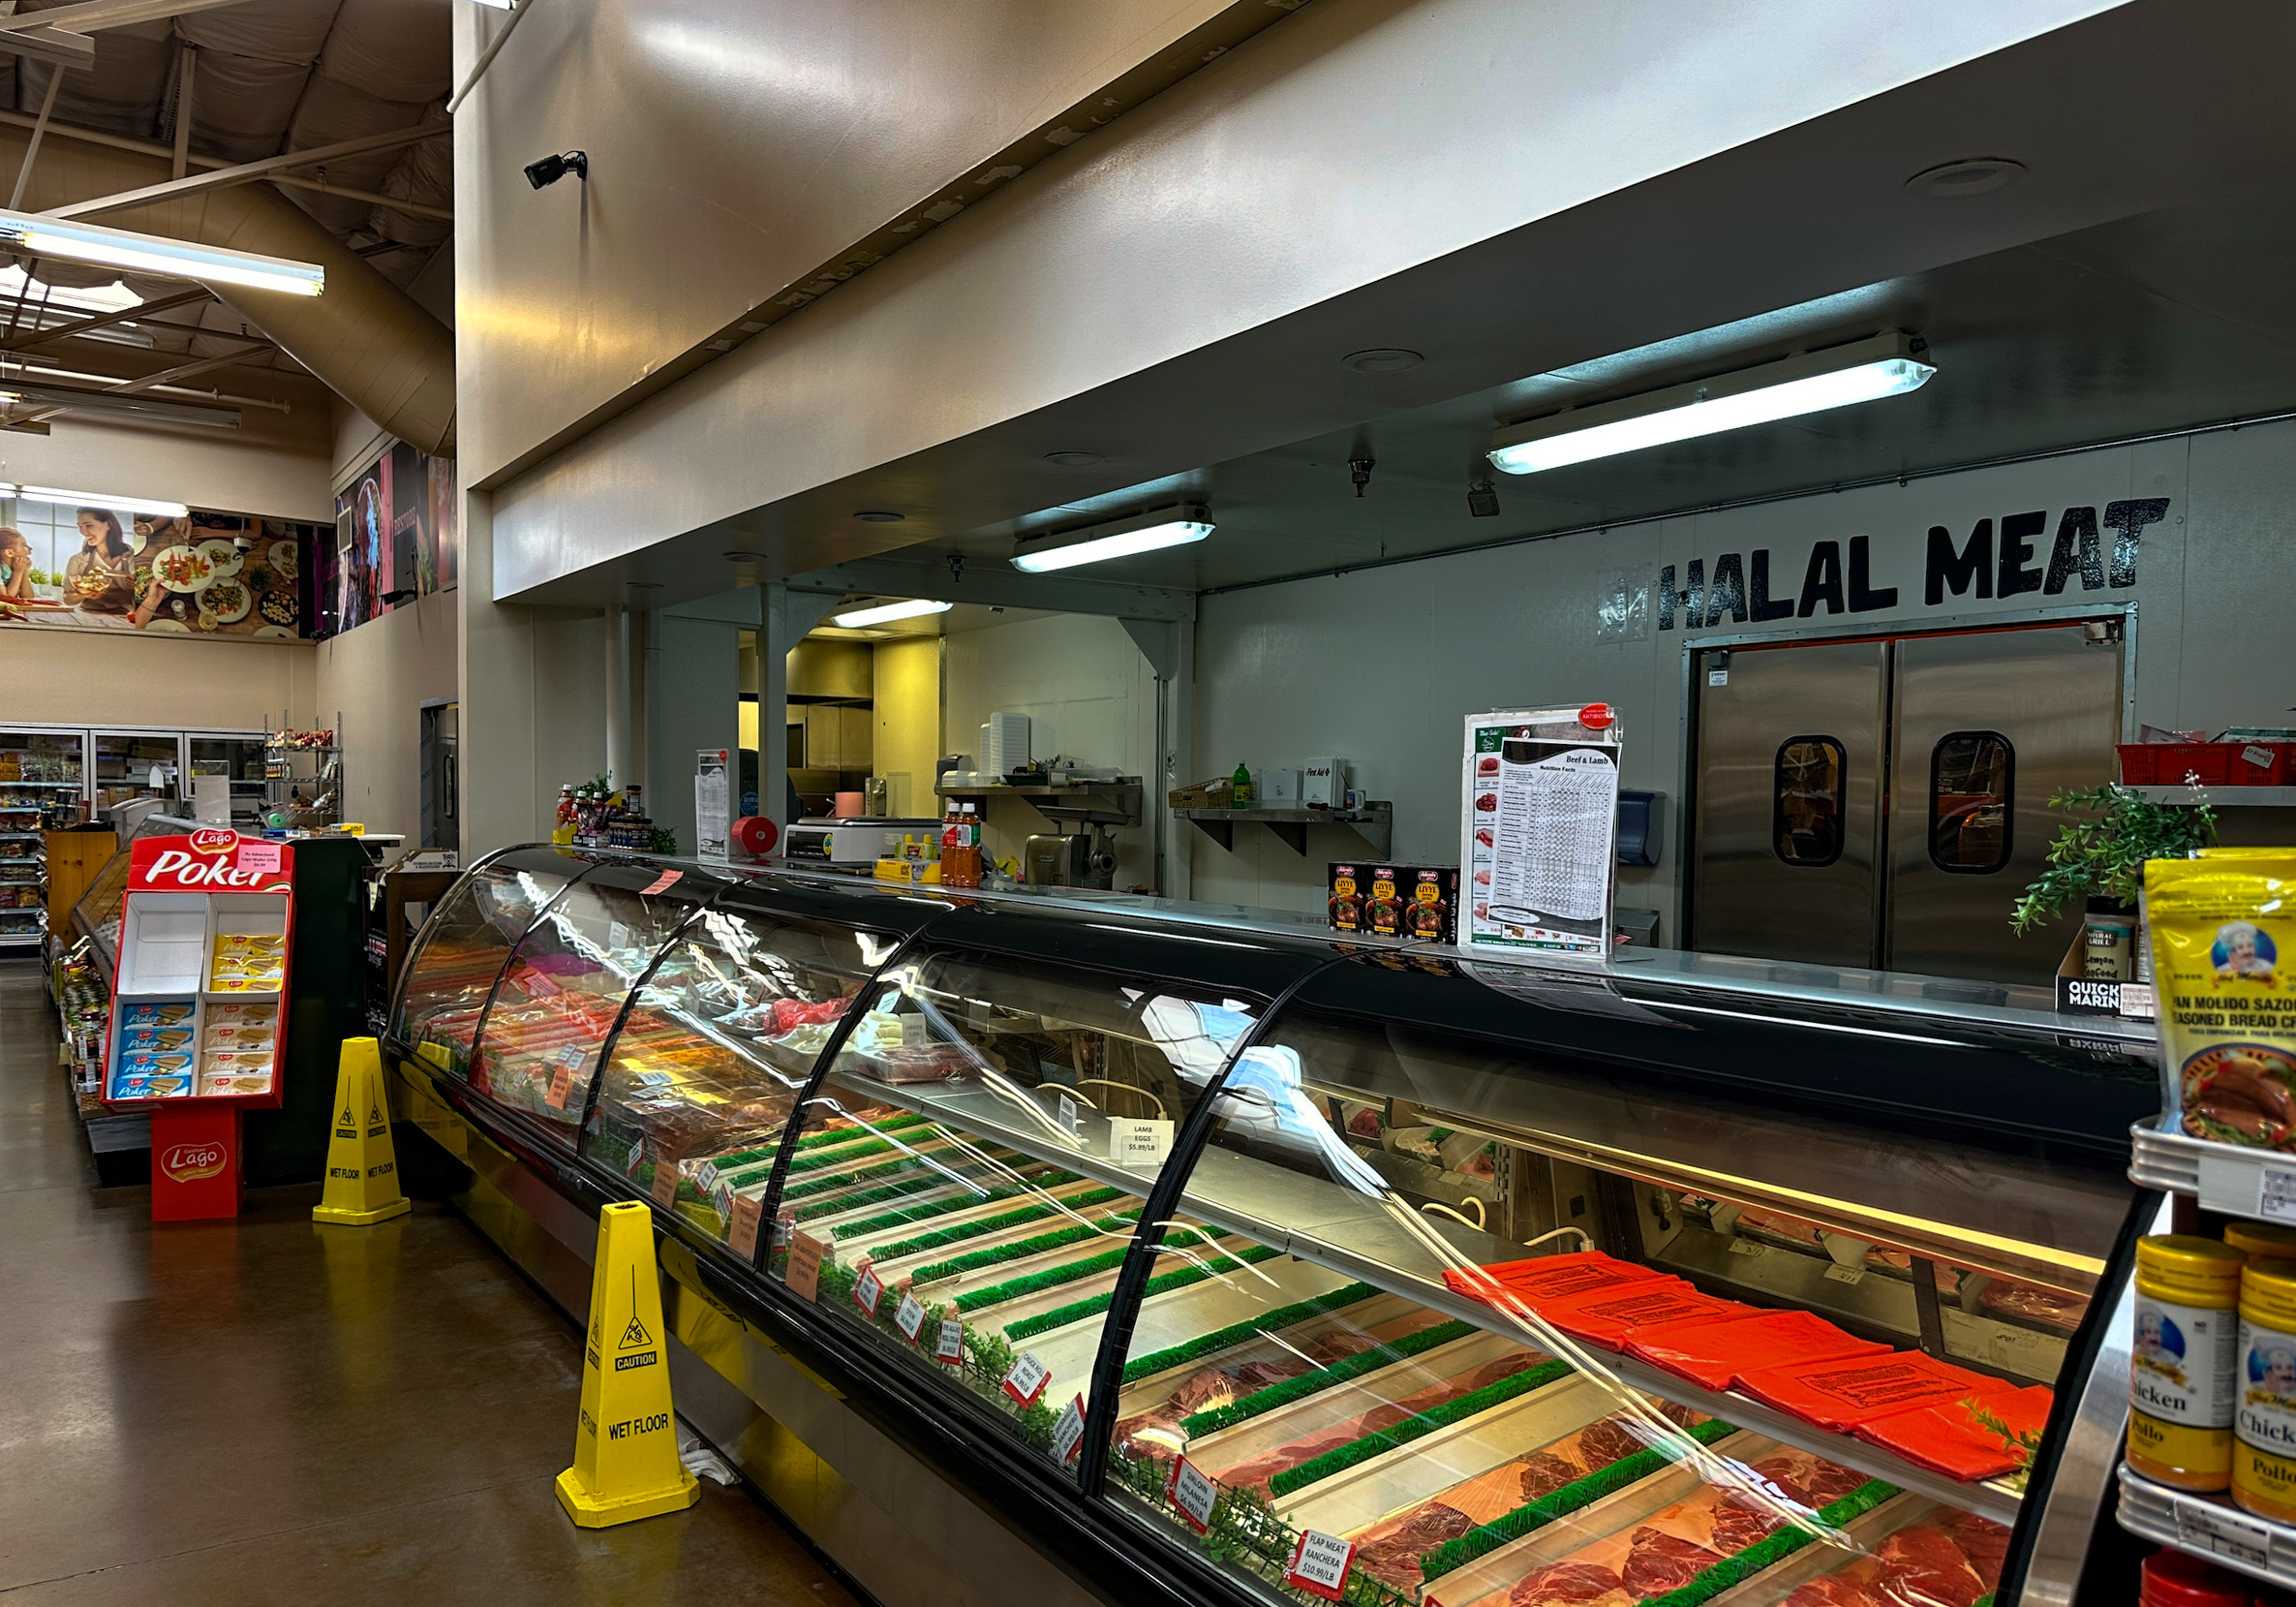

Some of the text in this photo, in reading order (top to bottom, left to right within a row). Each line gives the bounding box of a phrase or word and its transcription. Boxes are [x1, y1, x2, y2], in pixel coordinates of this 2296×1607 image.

[1659, 497, 2171, 631] HALAL MEAT
[1589, 756, 1608, 764] Lamb
[197, 830, 231, 846] Lago
[145, 850, 266, 887] Poker
[2068, 981, 2120, 997] QUICK
[2068, 992, 2121, 1009] MARIN
[2194, 997, 2249, 1009] MOLIDO
[2253, 998, 2296, 1011] SAZO
[129, 1014, 160, 1023] Poker
[2229, 1014, 2277, 1027] BREAD
[128, 1039, 159, 1048] Poker
[125, 1065, 156, 1073] Poker
[119, 1087, 151, 1097] Poker
[170, 1149, 218, 1169] Lago
[330, 1167, 359, 1180] WET FLOOR
[368, 1162, 393, 1178] WET FLOOR
[905, 1308, 916, 1319] STEW
[617, 1354, 655, 1369] CAUTION
[1023, 1353, 1045, 1377] CHUCK ROLL
[1022, 1367, 1035, 1381] ROAST
[2132, 1379, 2187, 1411] hicken
[609, 1413, 669, 1440] WET FLOOR
[2132, 1418, 2164, 1442] Pollo
[2240, 1409, 2296, 1443] Chick
[2252, 1458, 2296, 1483] Pollo
[1186, 1470, 1209, 1495] SIRLOIN
[1180, 1480, 1208, 1509] MILANESA
[1179, 1495, 1203, 1519] $6.99/LB
[1309, 1534, 1346, 1554] FLAP MEAT
[1304, 1550, 1340, 1568] RANCHERA
[1302, 1562, 1334, 1581] $10.99/LB
